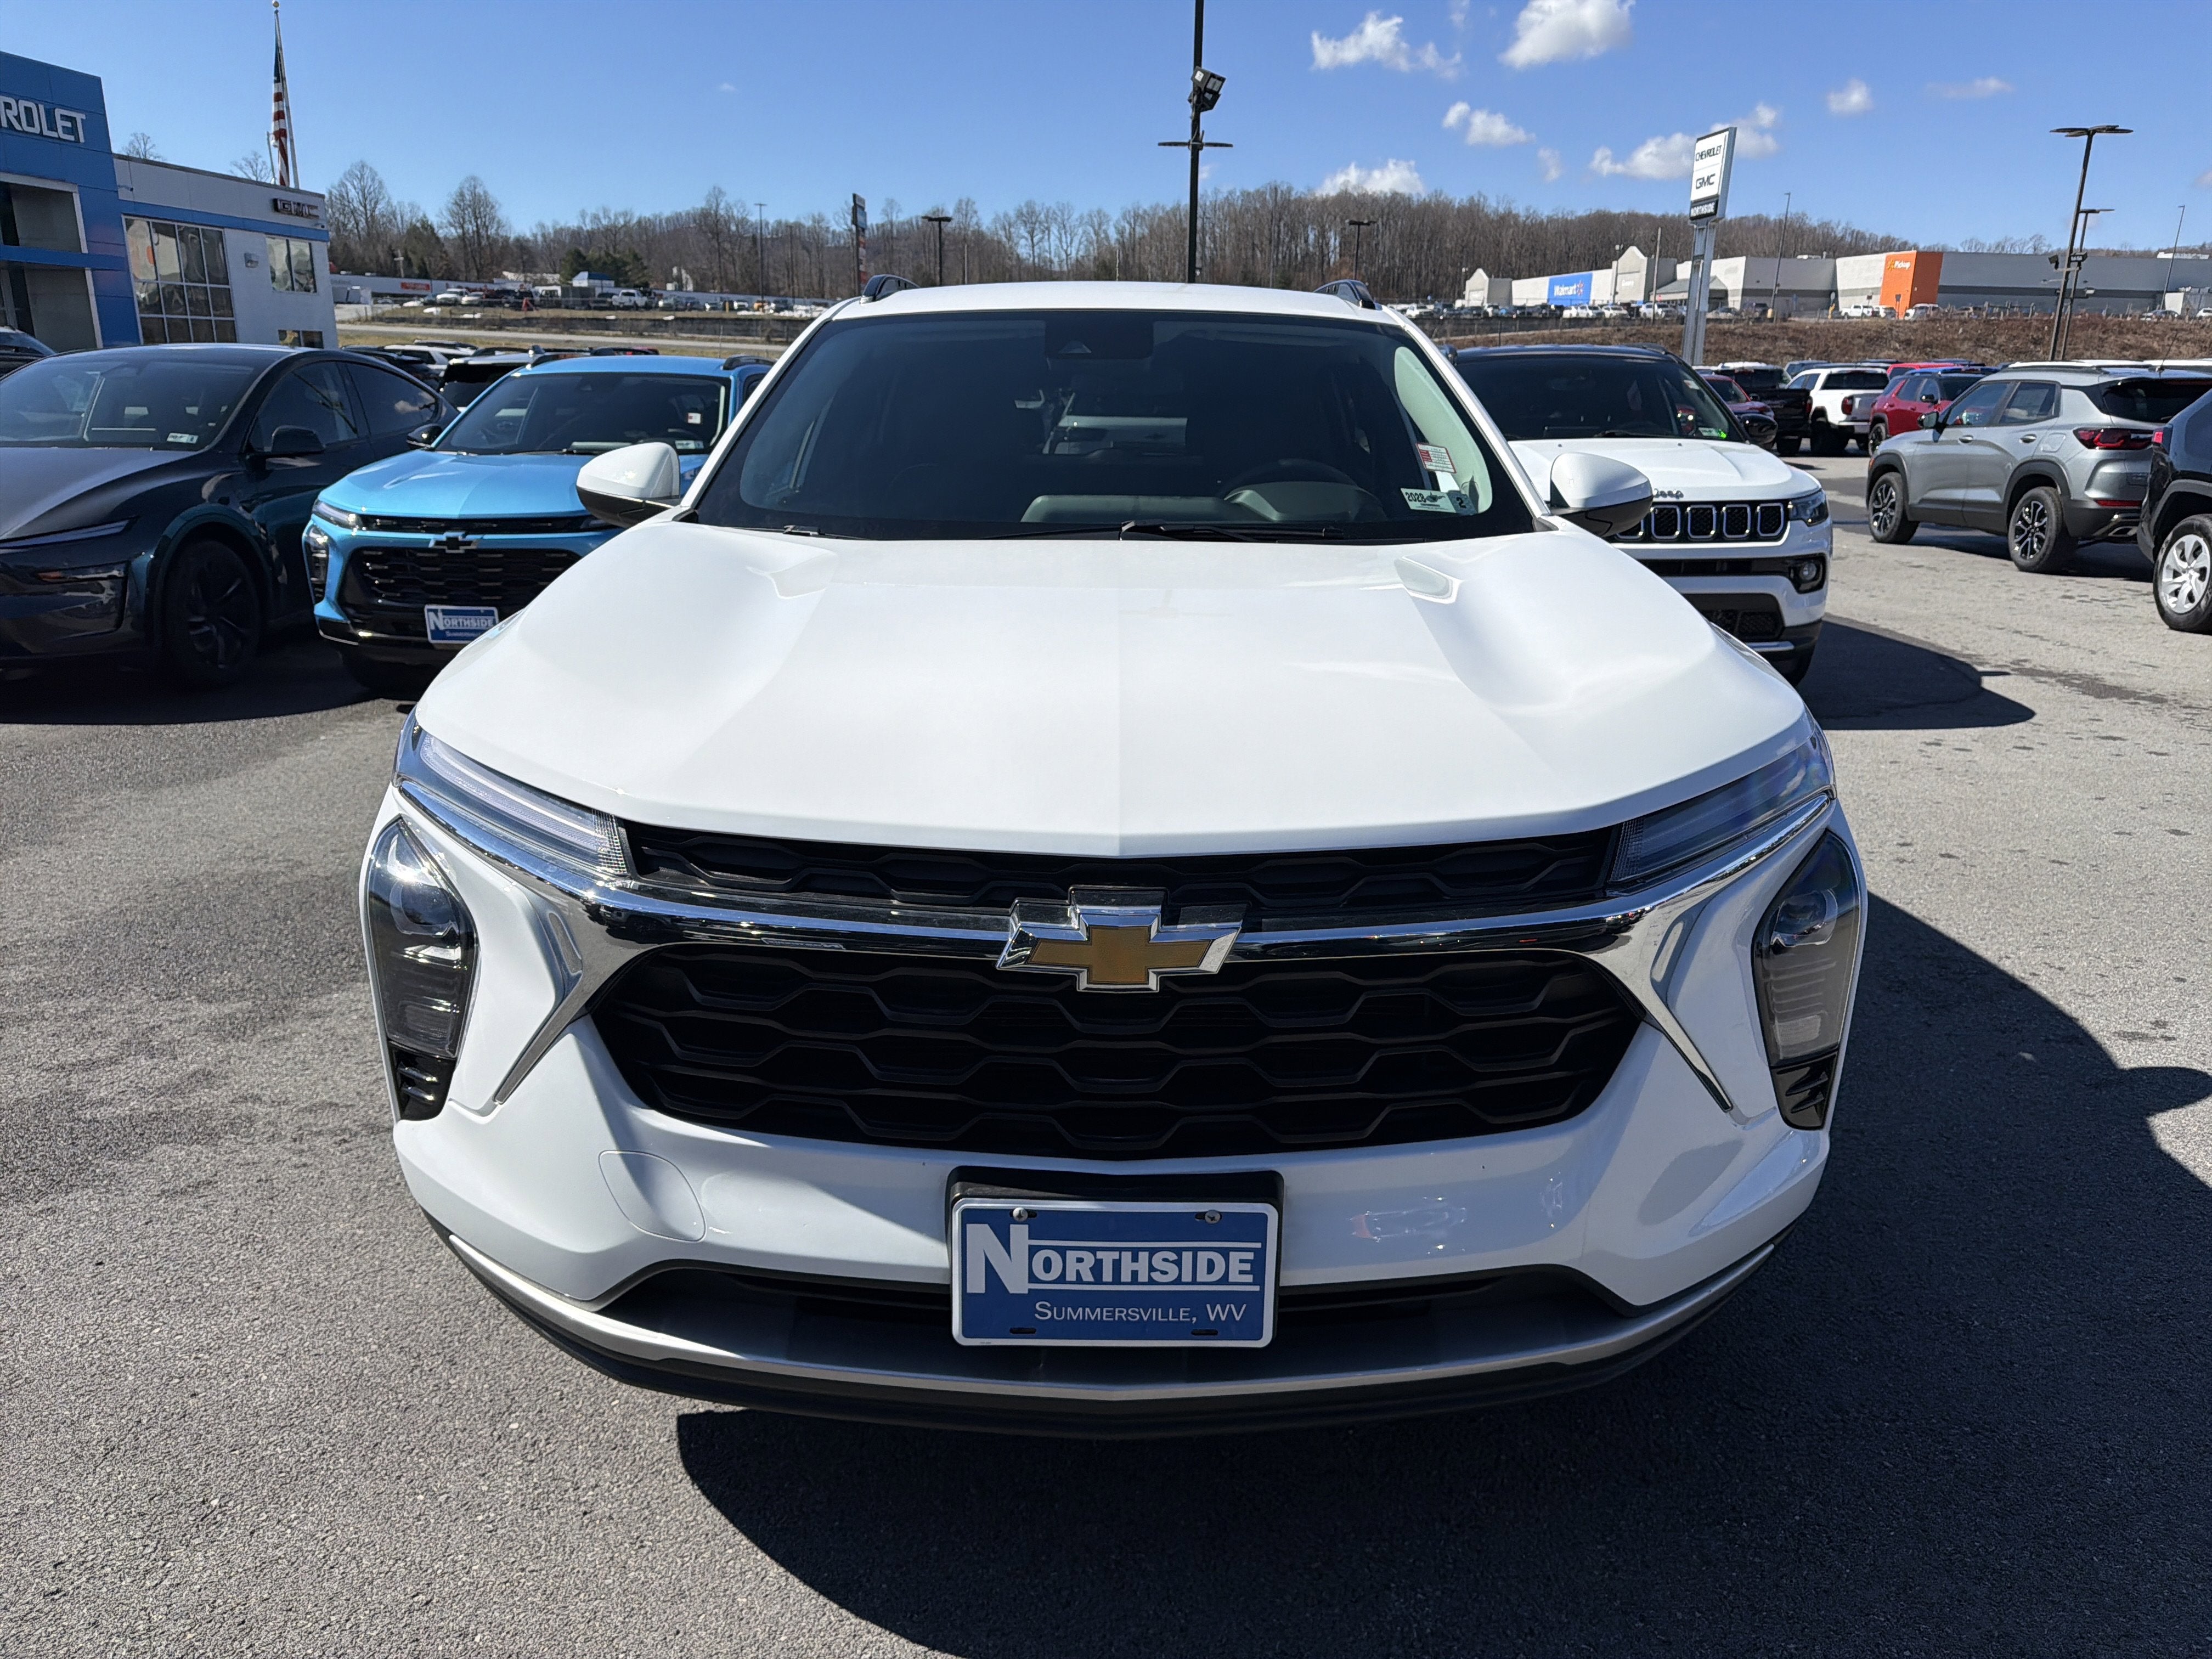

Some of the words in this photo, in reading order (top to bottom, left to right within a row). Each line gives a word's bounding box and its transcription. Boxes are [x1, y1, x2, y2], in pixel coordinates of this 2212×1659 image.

[0, 95, 86, 143] ROLET
[1695, 145, 1722, 161] CHEVROLET
[1696, 173, 1716, 189] GMC
[274, 199, 319, 219] GMC
[1894, 260, 1911, 270] Pickup
[1554, 283, 1577, 296] Walmart
[1654, 488, 1684, 499] Jeep
[1456, 497, 1466, 509] 2
[428, 611, 493, 630] NORTHSIDE
[967, 1223, 1254, 1294] NORTHSIDE
[1035, 1301, 1197, 1324] SUMMERSVILLE,
[1206, 1303, 1247, 1322] WV
